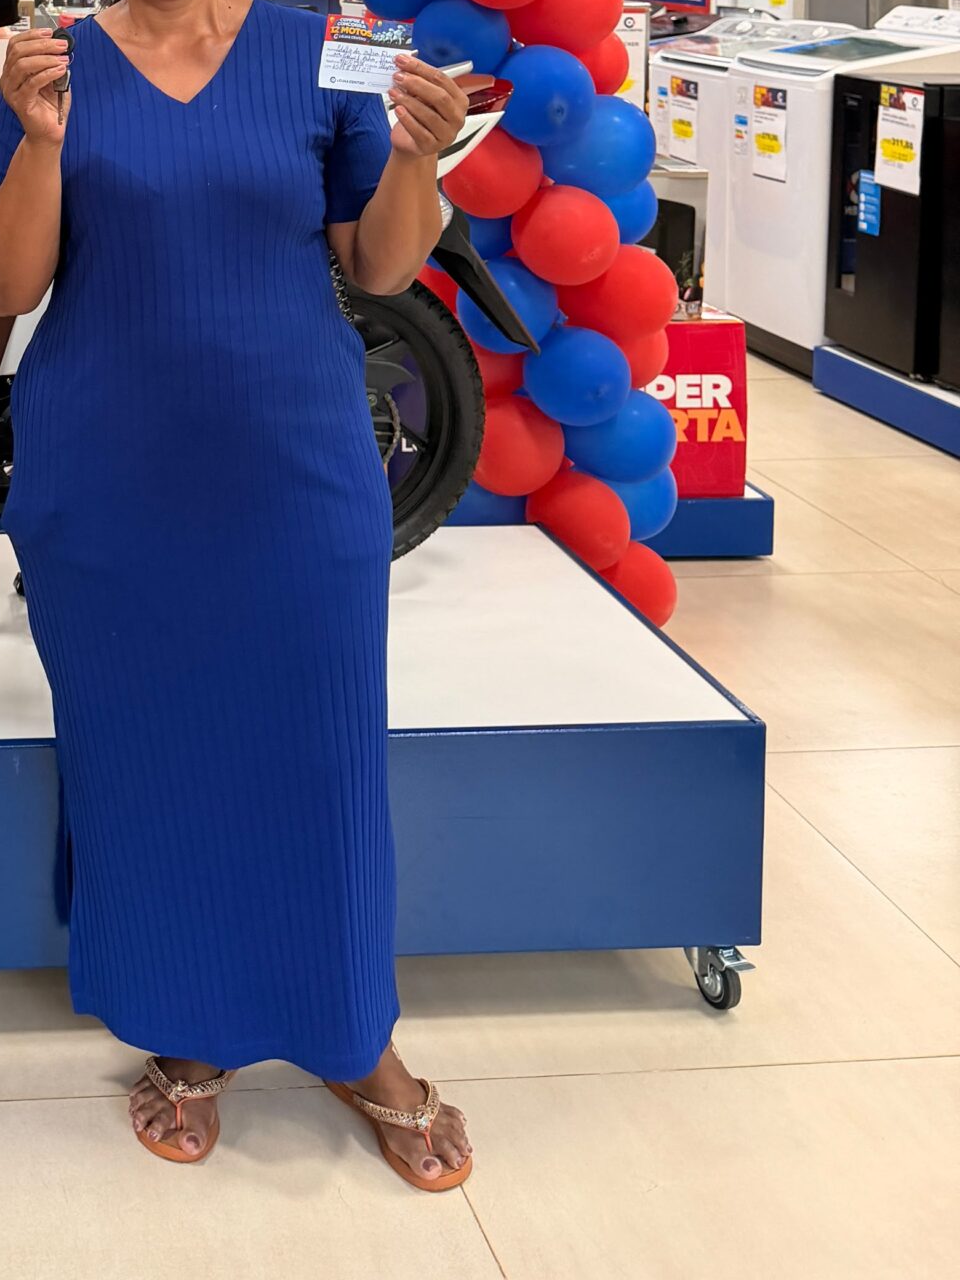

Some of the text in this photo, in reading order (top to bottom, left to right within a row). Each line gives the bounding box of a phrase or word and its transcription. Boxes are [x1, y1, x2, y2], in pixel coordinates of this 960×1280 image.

[340, 26, 373, 38] MOTOS
[639, 374, 733, 408] PER
[669, 409, 746, 442] RTA
